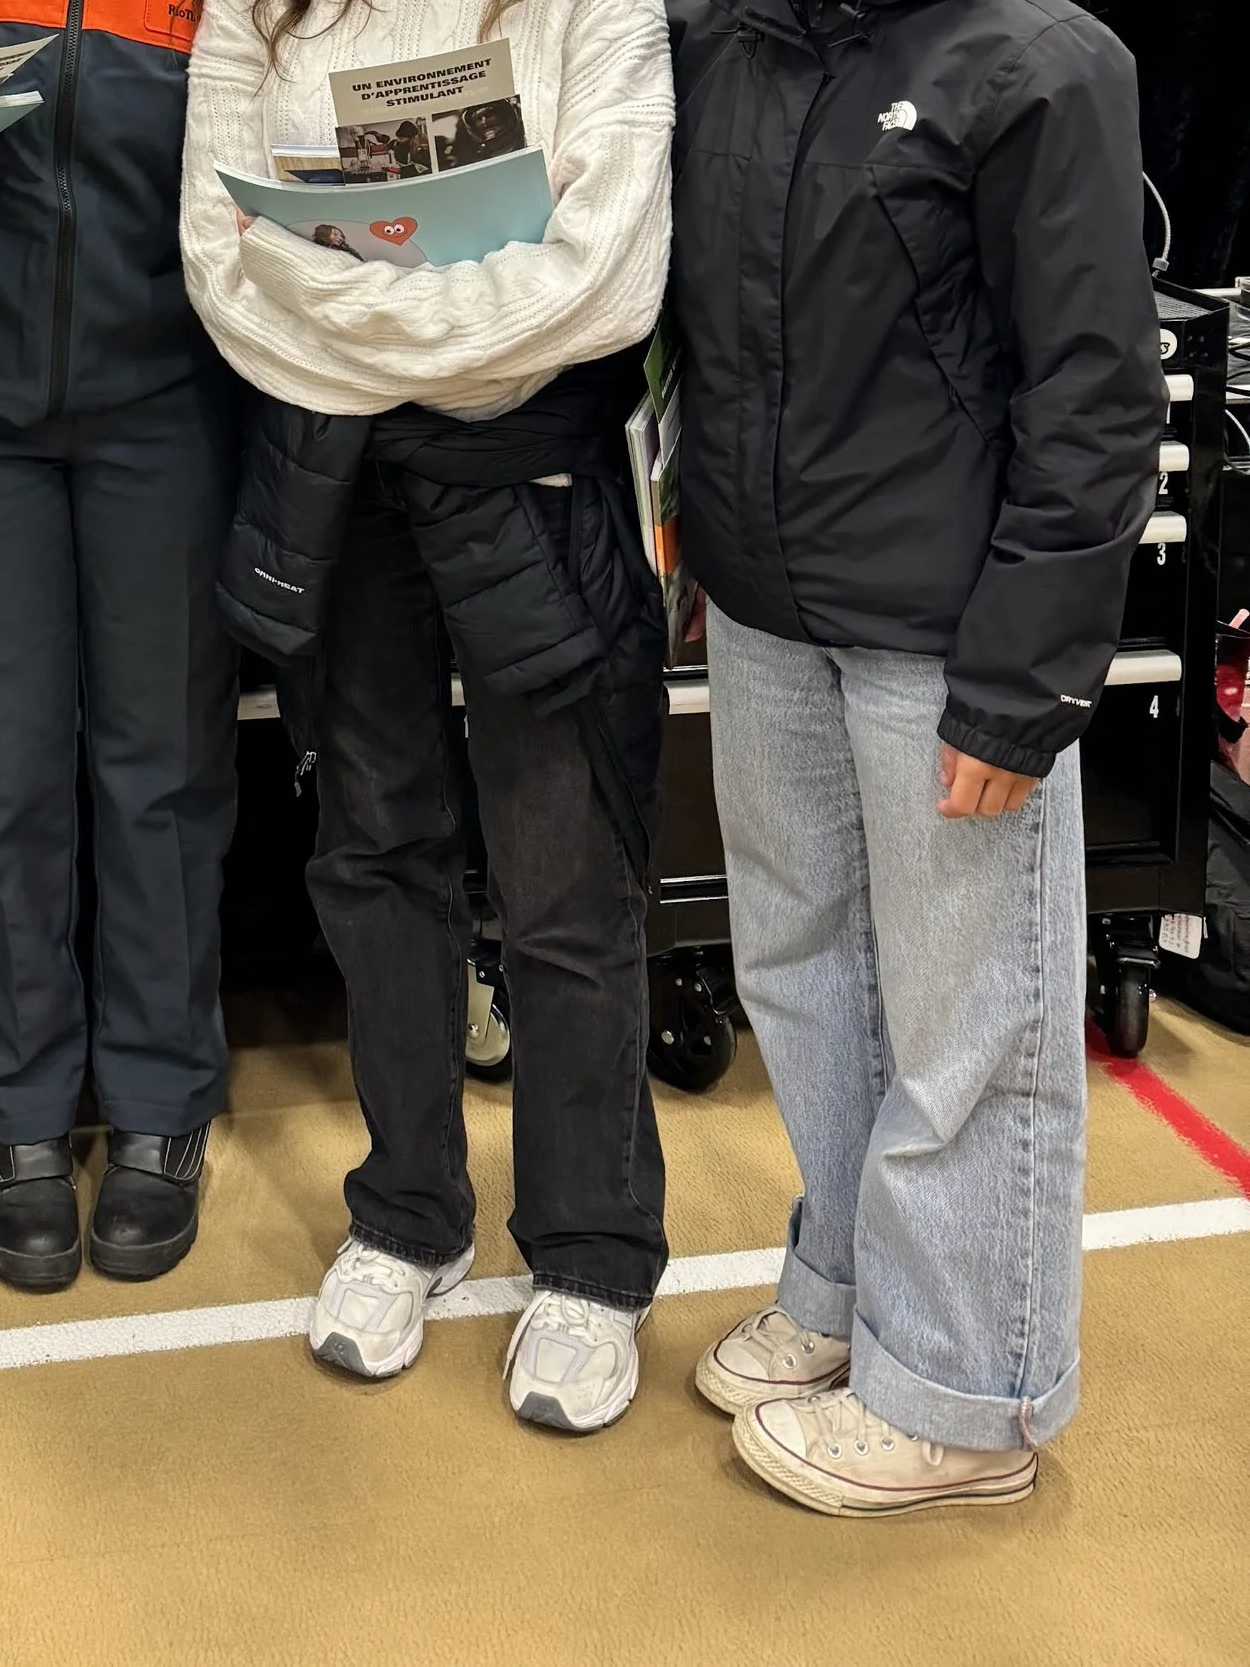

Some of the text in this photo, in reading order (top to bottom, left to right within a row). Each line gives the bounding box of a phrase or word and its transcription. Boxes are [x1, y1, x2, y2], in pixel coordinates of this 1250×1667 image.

[352, 58, 492, 92] UN ENVIRONNEMENT
[386, 86, 464, 107] STIMULANT
[1158, 472, 1168, 495] 2
[1156, 542, 1167, 566] 3
[1149, 694, 1159, 718] 4
